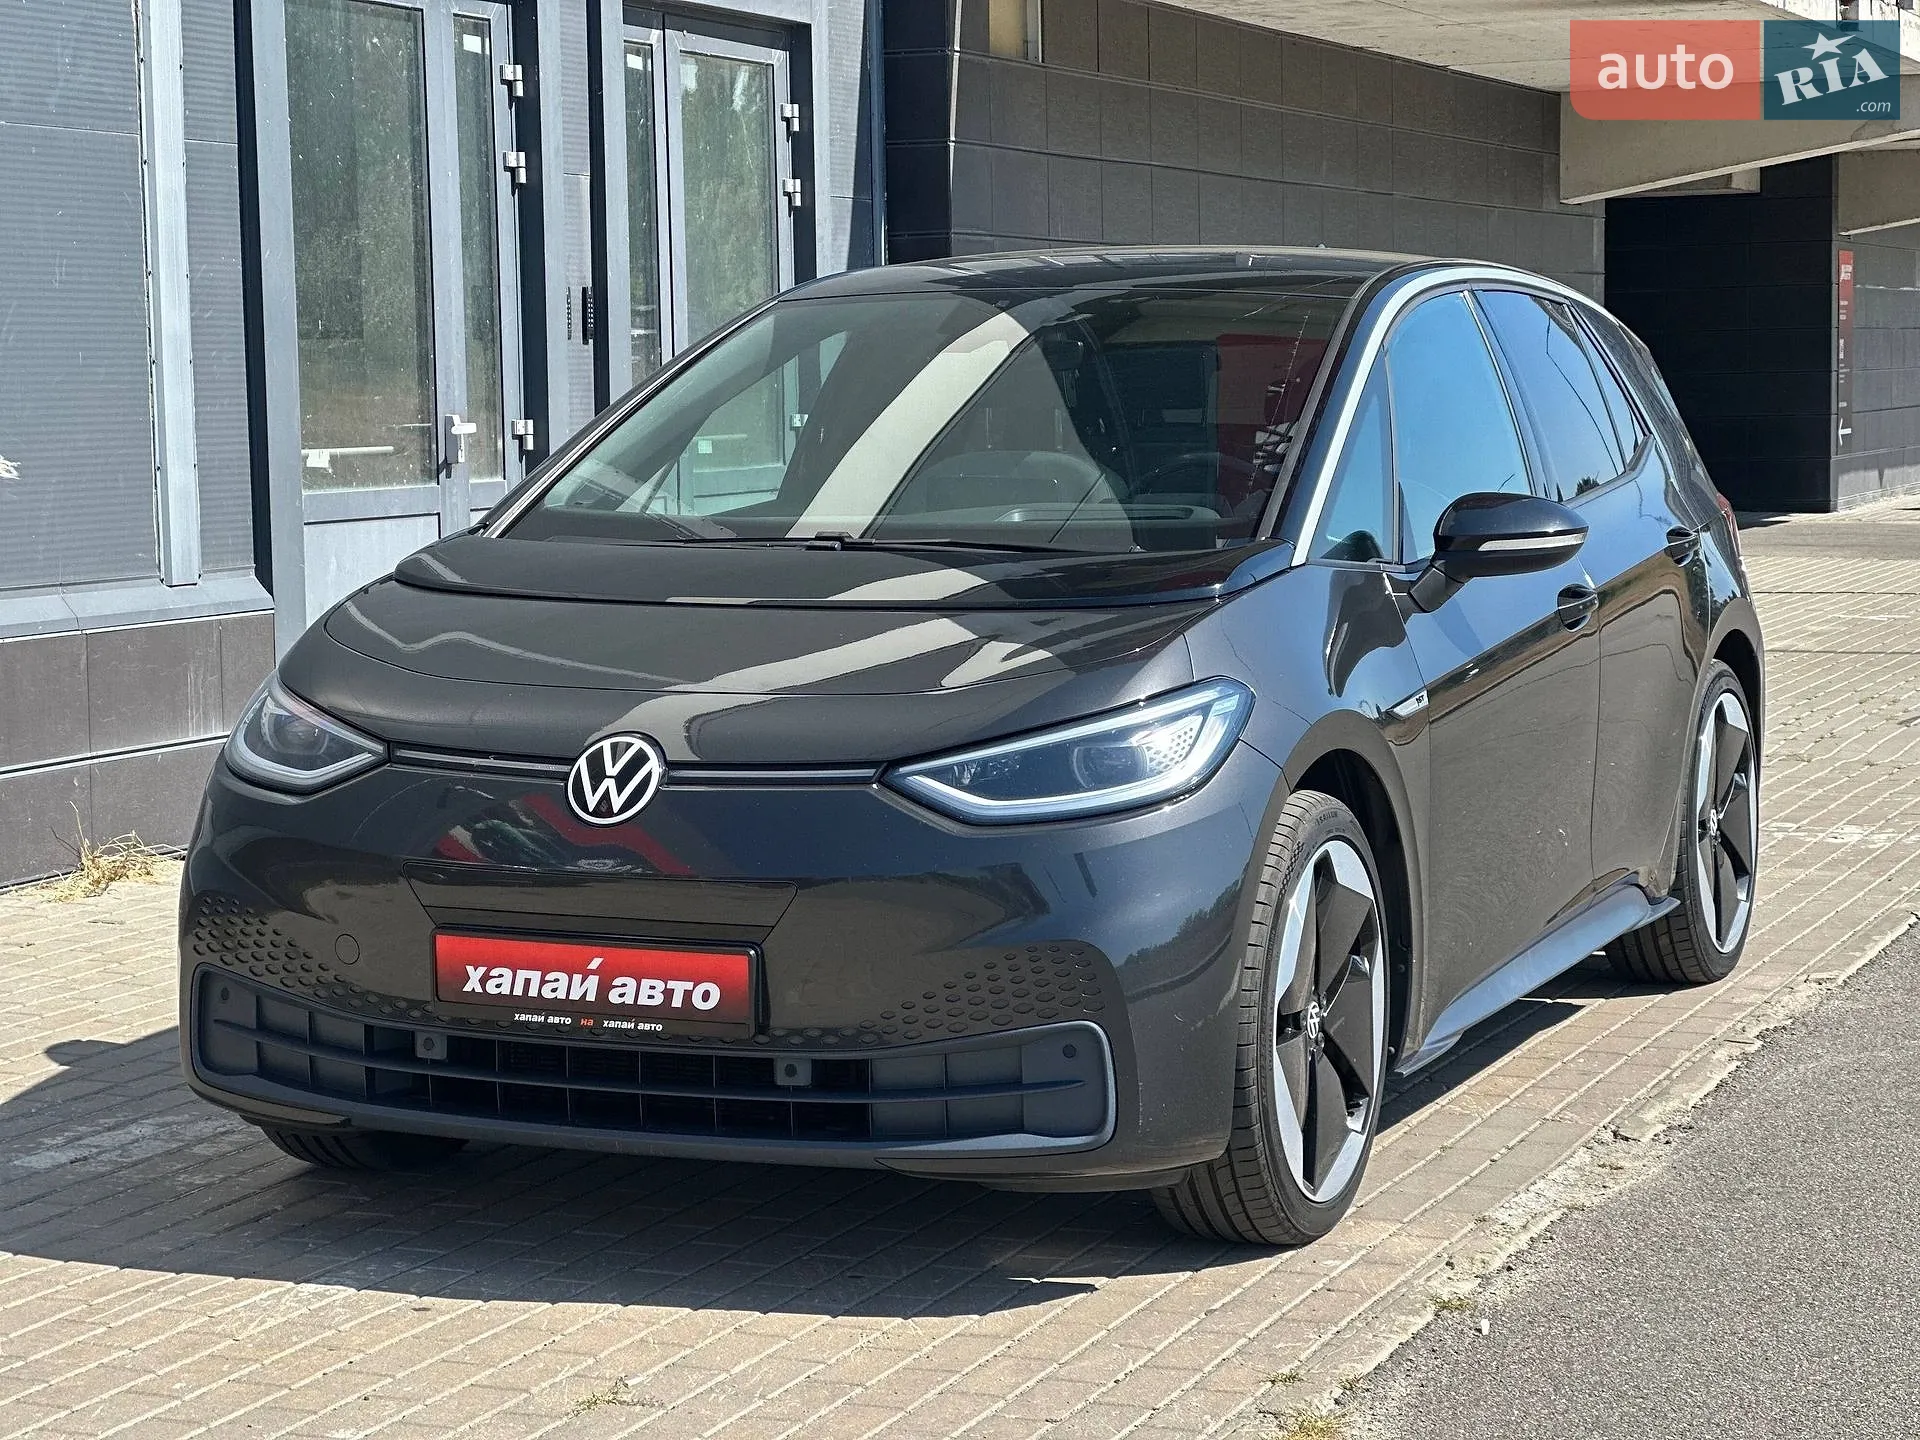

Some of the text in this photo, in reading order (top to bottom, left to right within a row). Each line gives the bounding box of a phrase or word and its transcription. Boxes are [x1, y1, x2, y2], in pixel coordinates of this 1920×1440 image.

[608, 976, 721, 1011] авто
[547, 1015, 572, 1025] авто
[580, 1017, 594, 1026] на
[638, 1022, 663, 1032] авто
